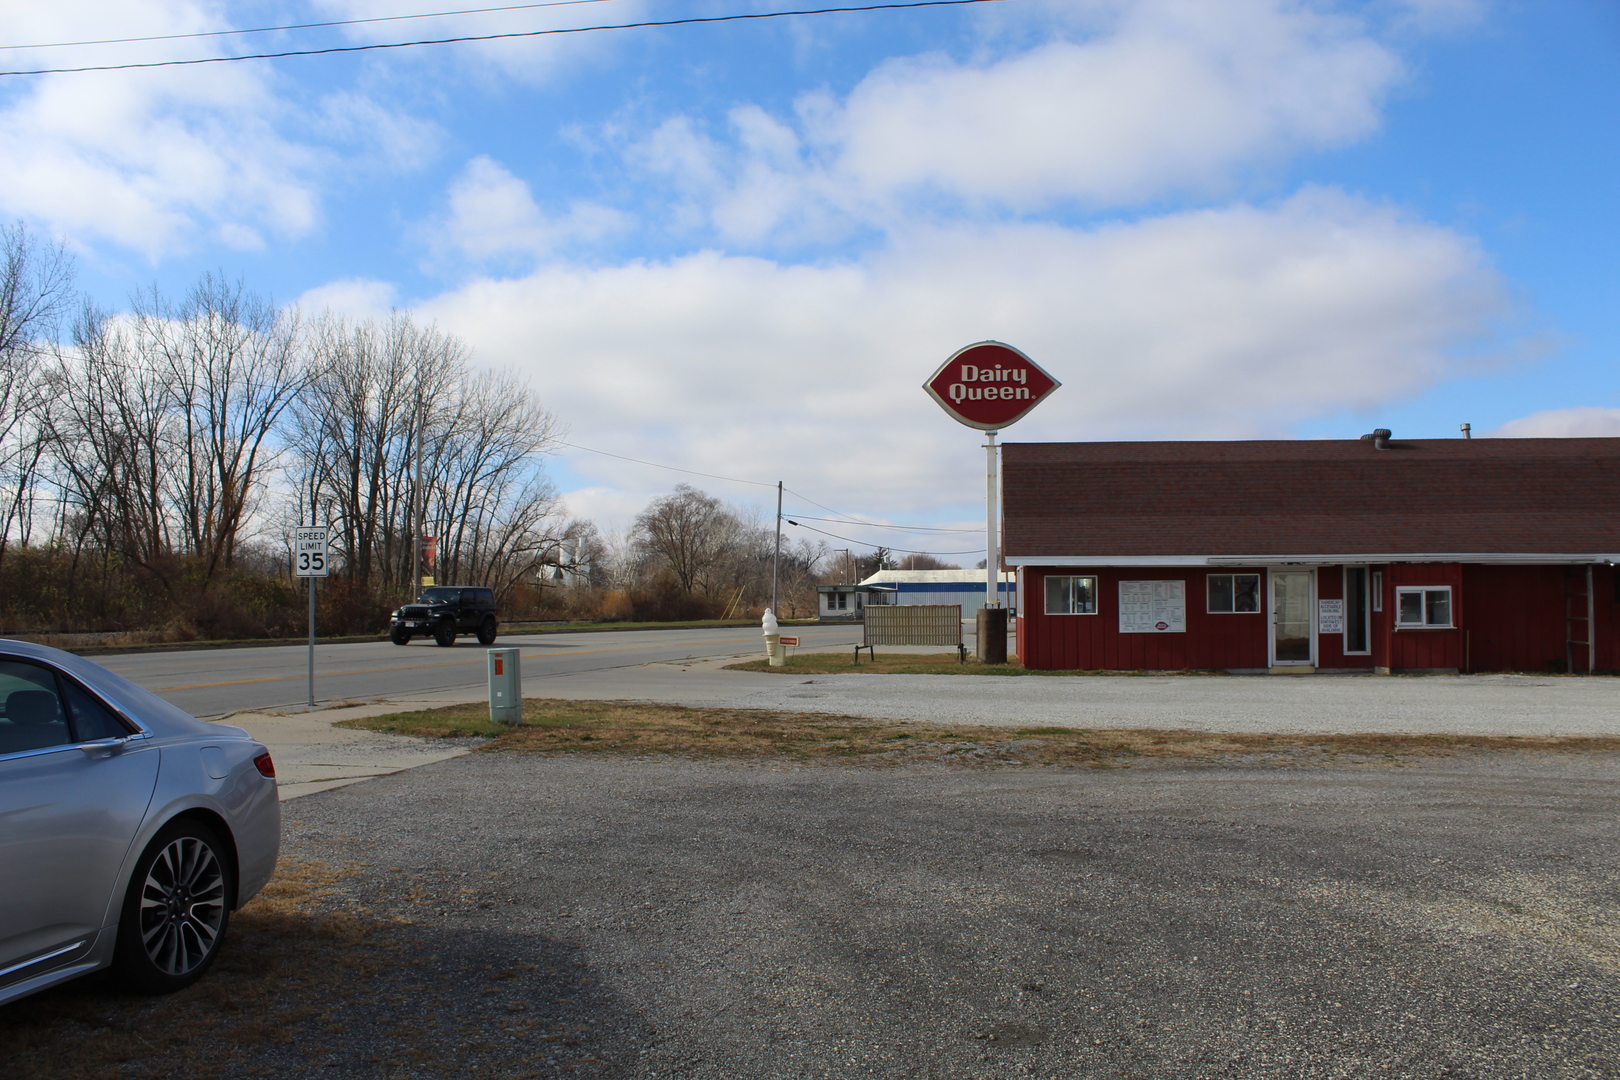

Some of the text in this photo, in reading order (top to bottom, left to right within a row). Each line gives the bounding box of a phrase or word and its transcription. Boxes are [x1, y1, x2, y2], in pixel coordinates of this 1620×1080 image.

[961, 364, 1027, 385] Dairy
[949, 383, 1030, 405] Queen
[298, 532, 326, 540] SPEED
[300, 542, 322, 550] LIMIT
[299, 552, 324, 571] 35
